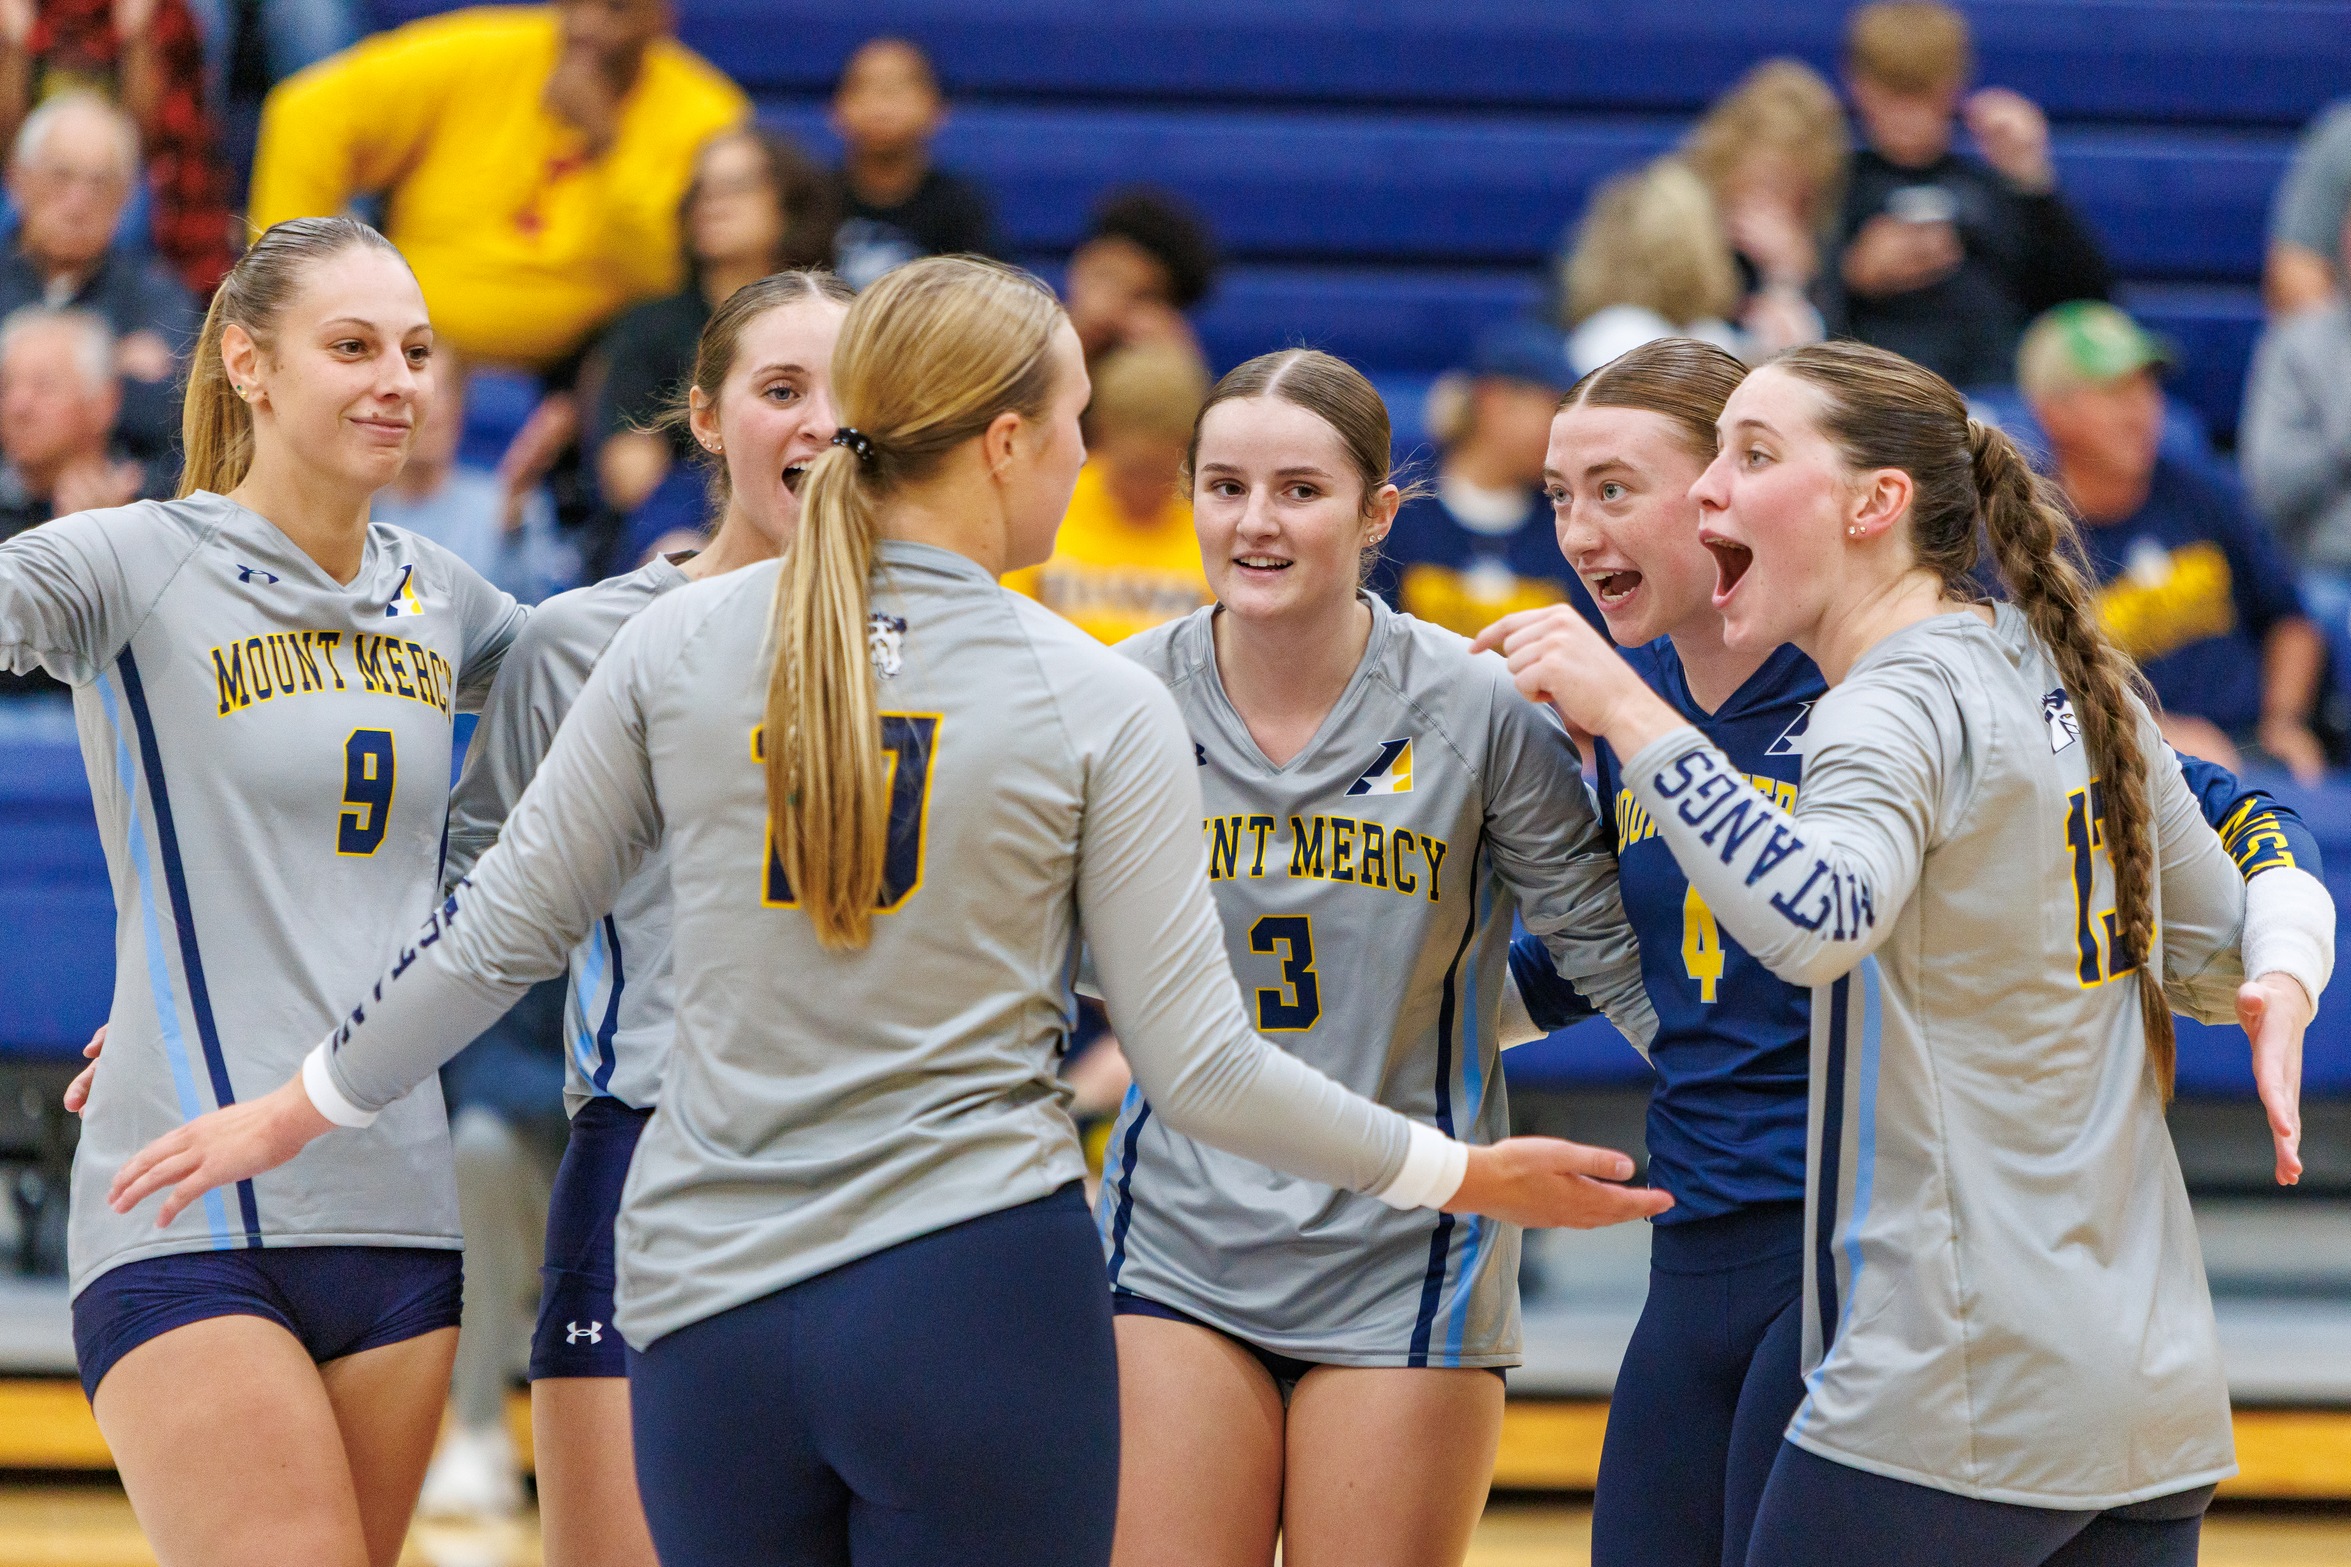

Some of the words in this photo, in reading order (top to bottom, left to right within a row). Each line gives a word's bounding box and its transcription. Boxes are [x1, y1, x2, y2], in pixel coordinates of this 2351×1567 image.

[210, 630, 346, 719] MOUNT
[335, 727, 397, 858] 9
[1288, 814, 1448, 903] MERCY
[1248, 913, 1322, 1033] 3
[1681, 882, 1725, 1004] 4
